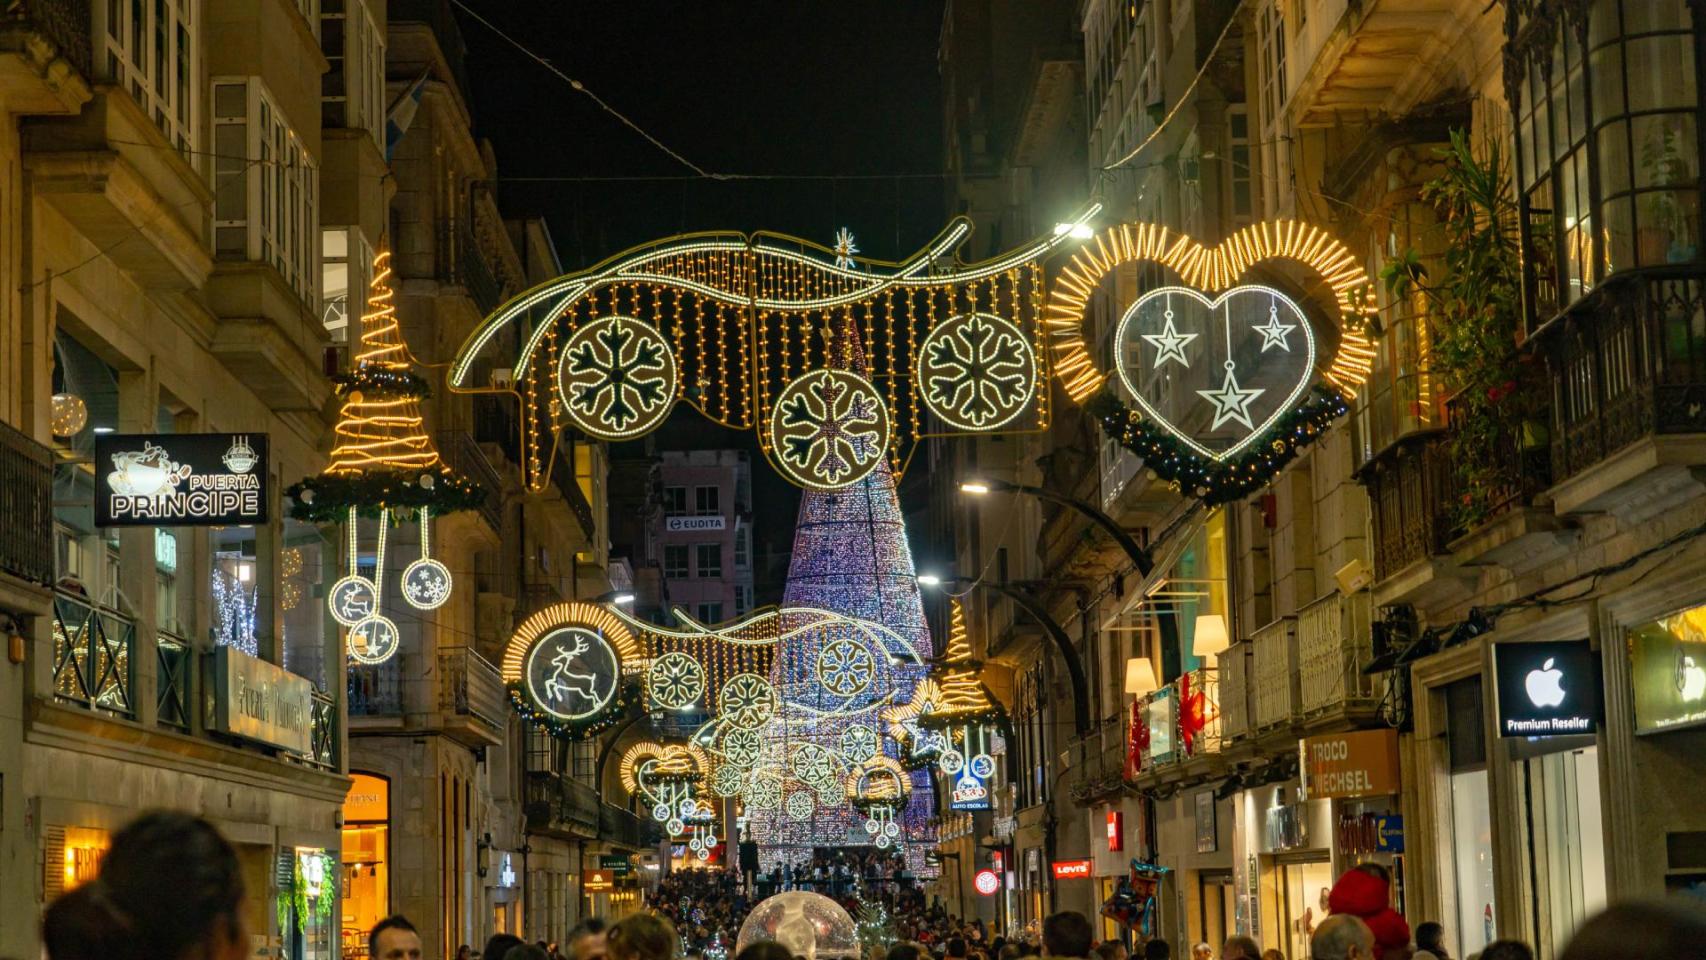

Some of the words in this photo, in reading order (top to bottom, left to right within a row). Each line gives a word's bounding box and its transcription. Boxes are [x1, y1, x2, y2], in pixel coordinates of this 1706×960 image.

[190, 473, 260, 490] PUERTA
[111, 490, 259, 518] PRINCIPE
[684, 519, 722, 528] EUDITA
[1507, 718, 1550, 731] Premium
[1552, 717, 1589, 730] Reseller
[1313, 740, 1348, 763] TROCO
[1314, 768, 1373, 794] WECHSEL
